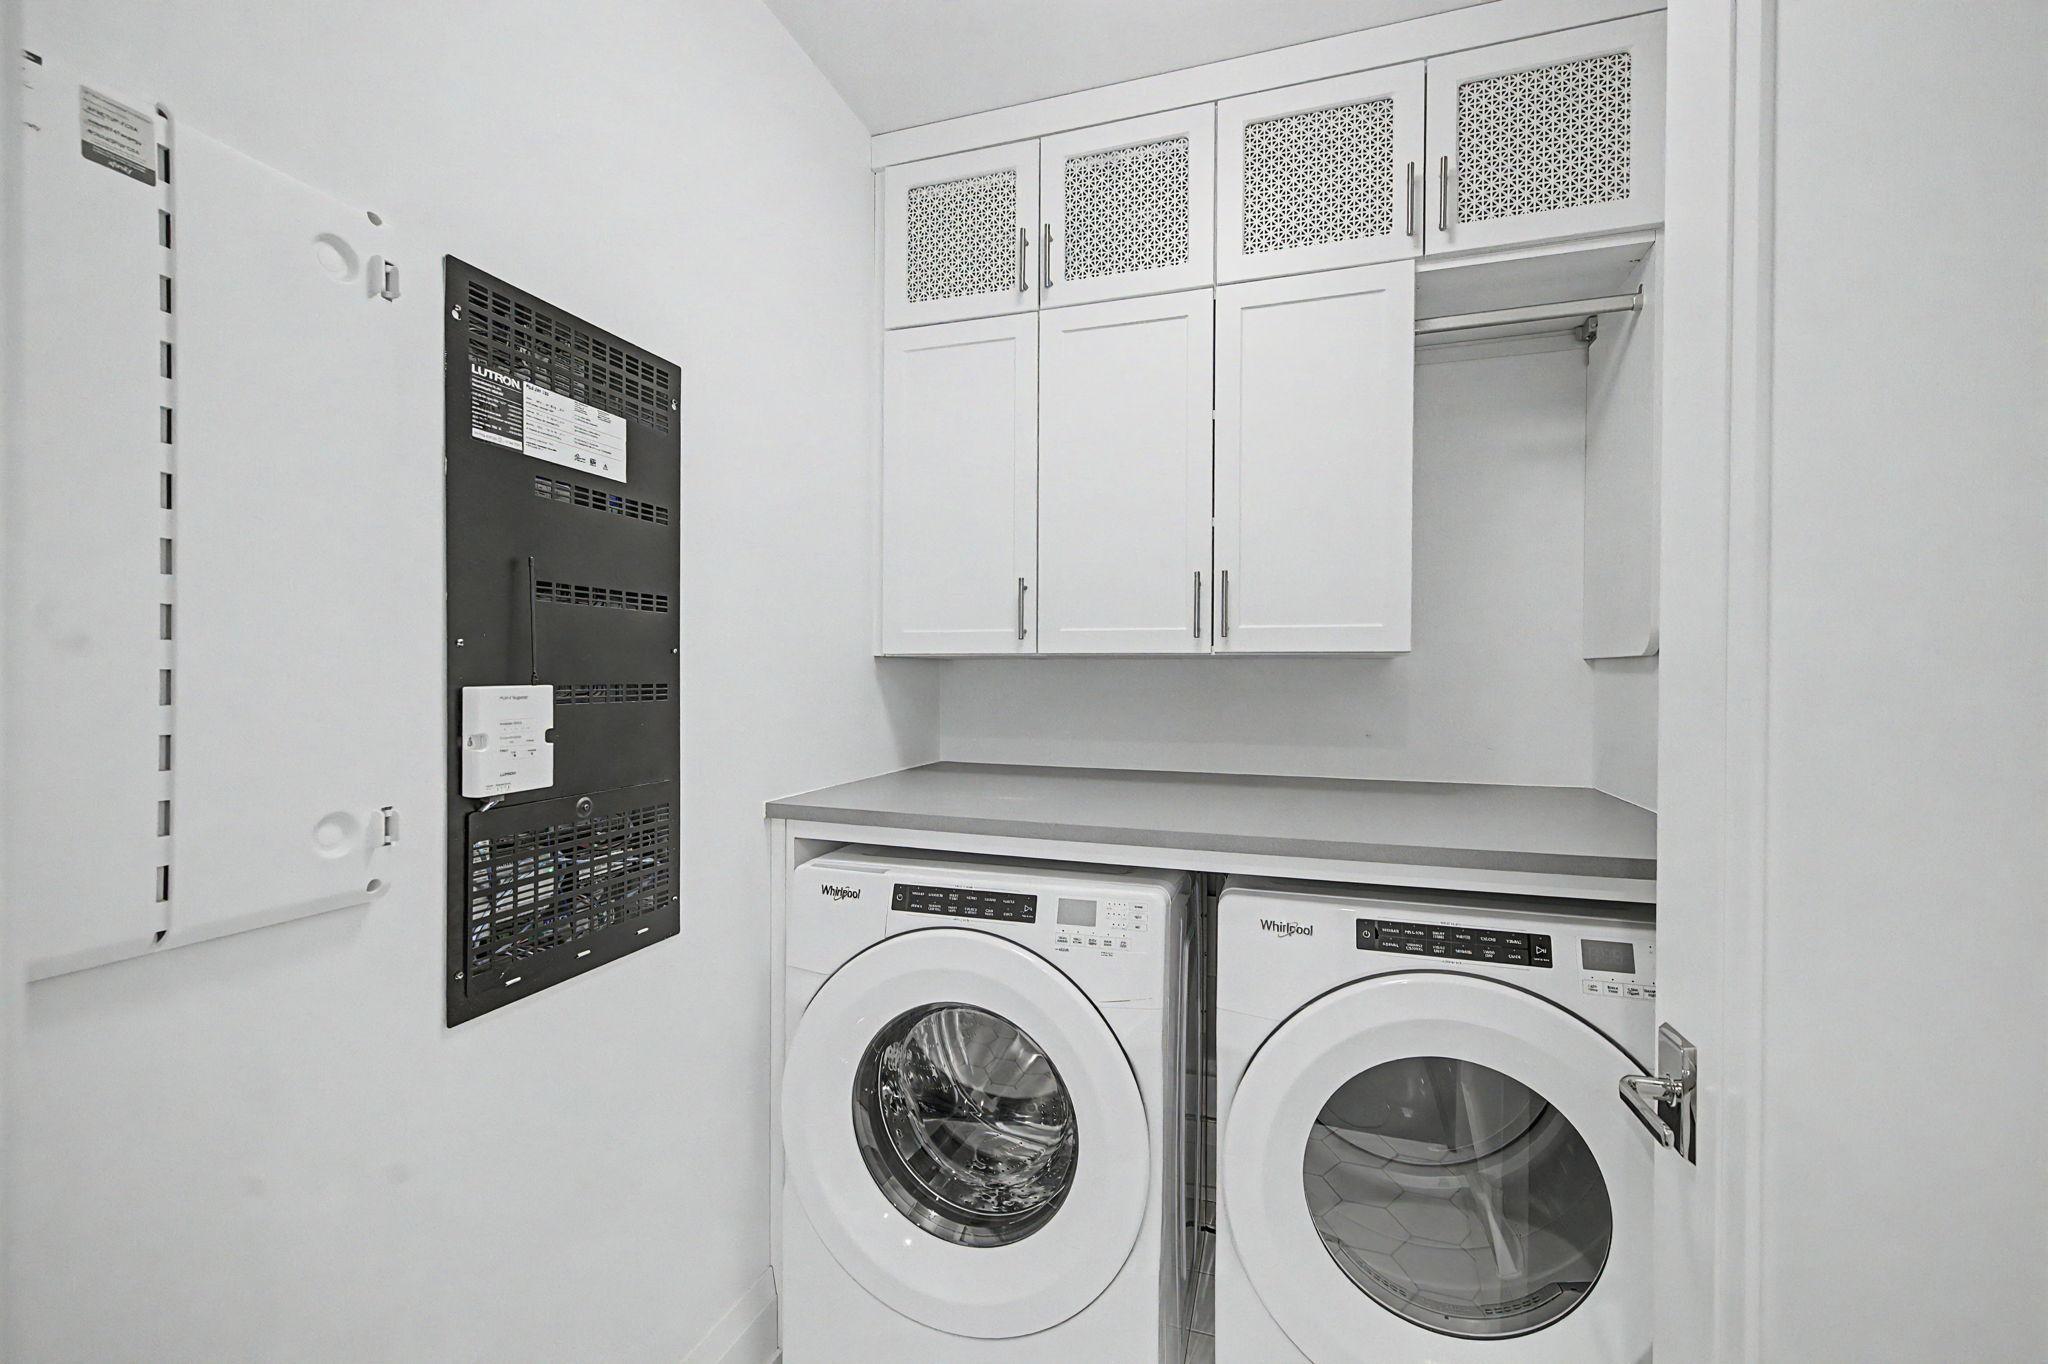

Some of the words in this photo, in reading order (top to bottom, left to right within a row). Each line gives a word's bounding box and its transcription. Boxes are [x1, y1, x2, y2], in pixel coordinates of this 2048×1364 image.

[471, 363, 521, 390] LUTRON
[821, 884, 861, 901] Whirlpool
[1260, 918, 1313, 938] Whirlpool
